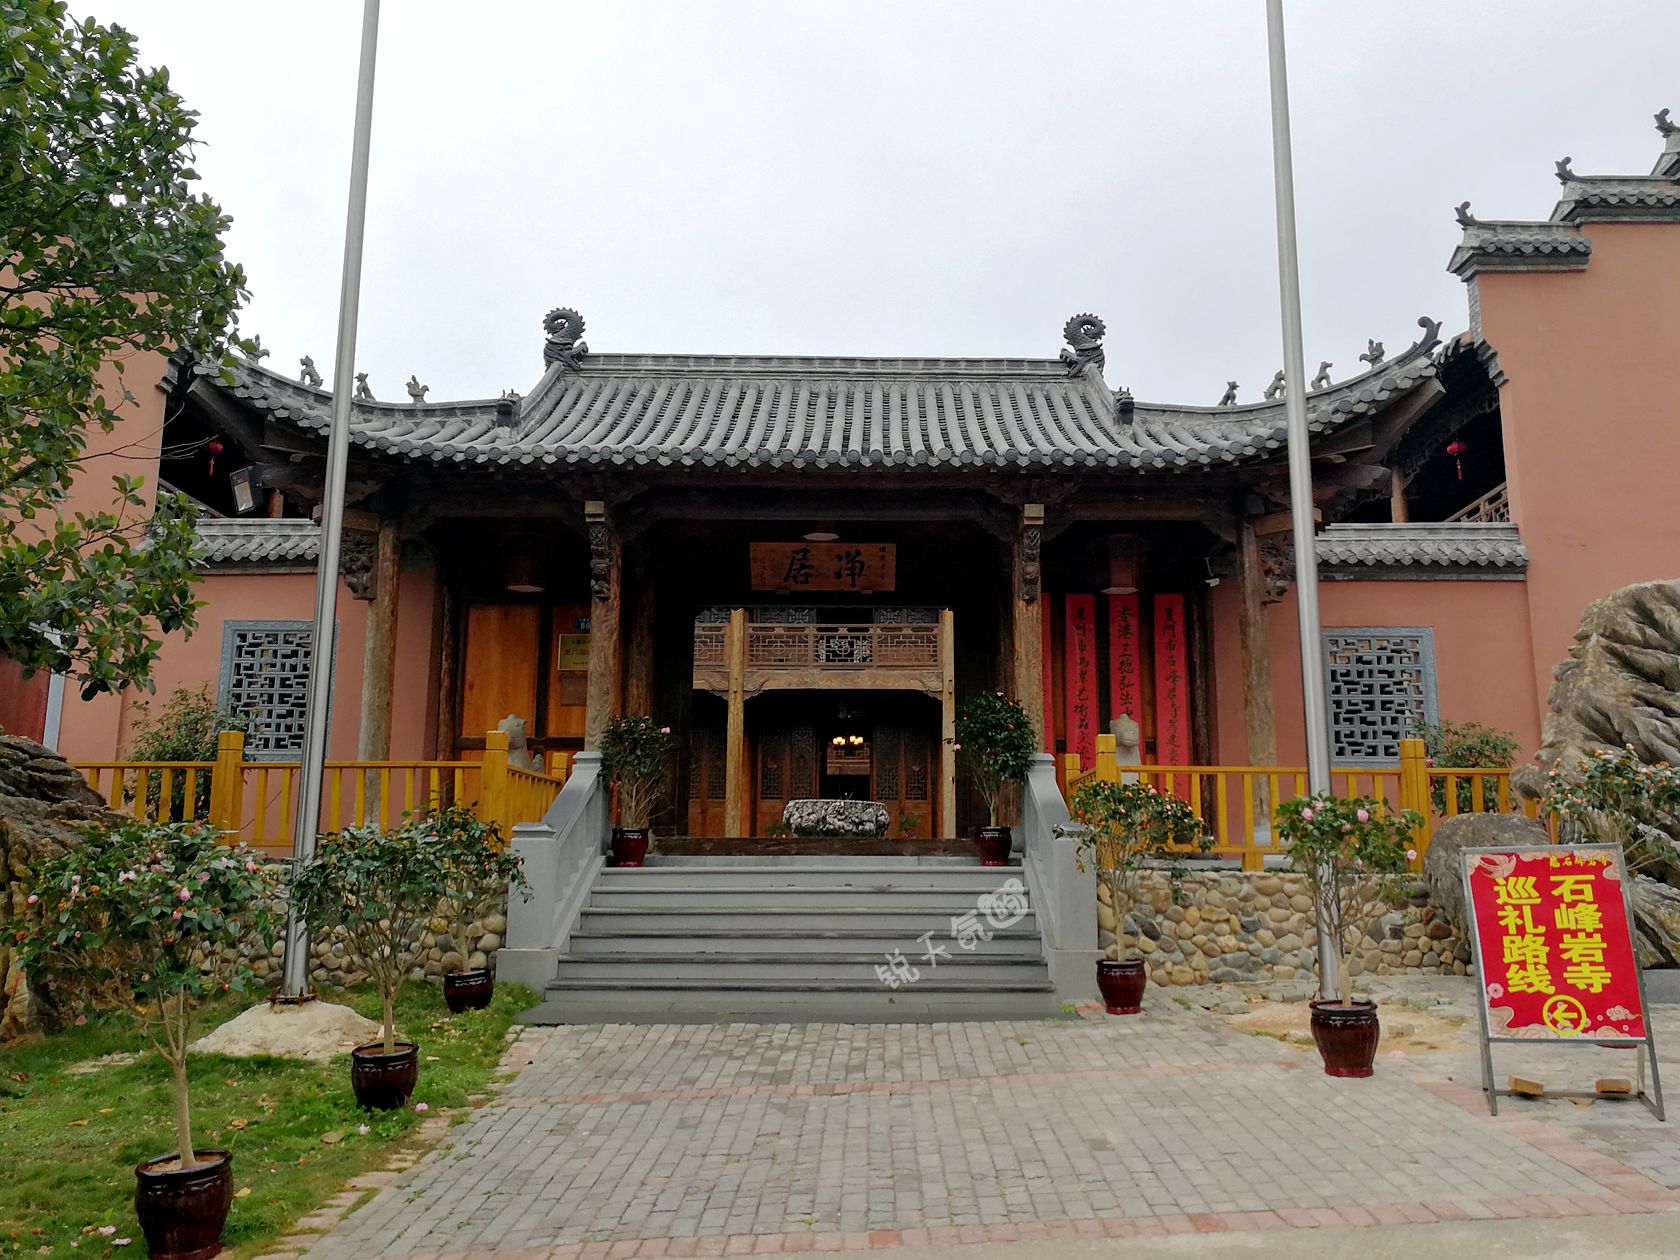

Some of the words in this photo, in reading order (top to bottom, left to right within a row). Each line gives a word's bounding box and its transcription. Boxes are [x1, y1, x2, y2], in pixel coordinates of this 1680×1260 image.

[1493, 876, 1556, 995] 巡礼路线
[1550, 874, 1612, 993] 石峰岩寺
